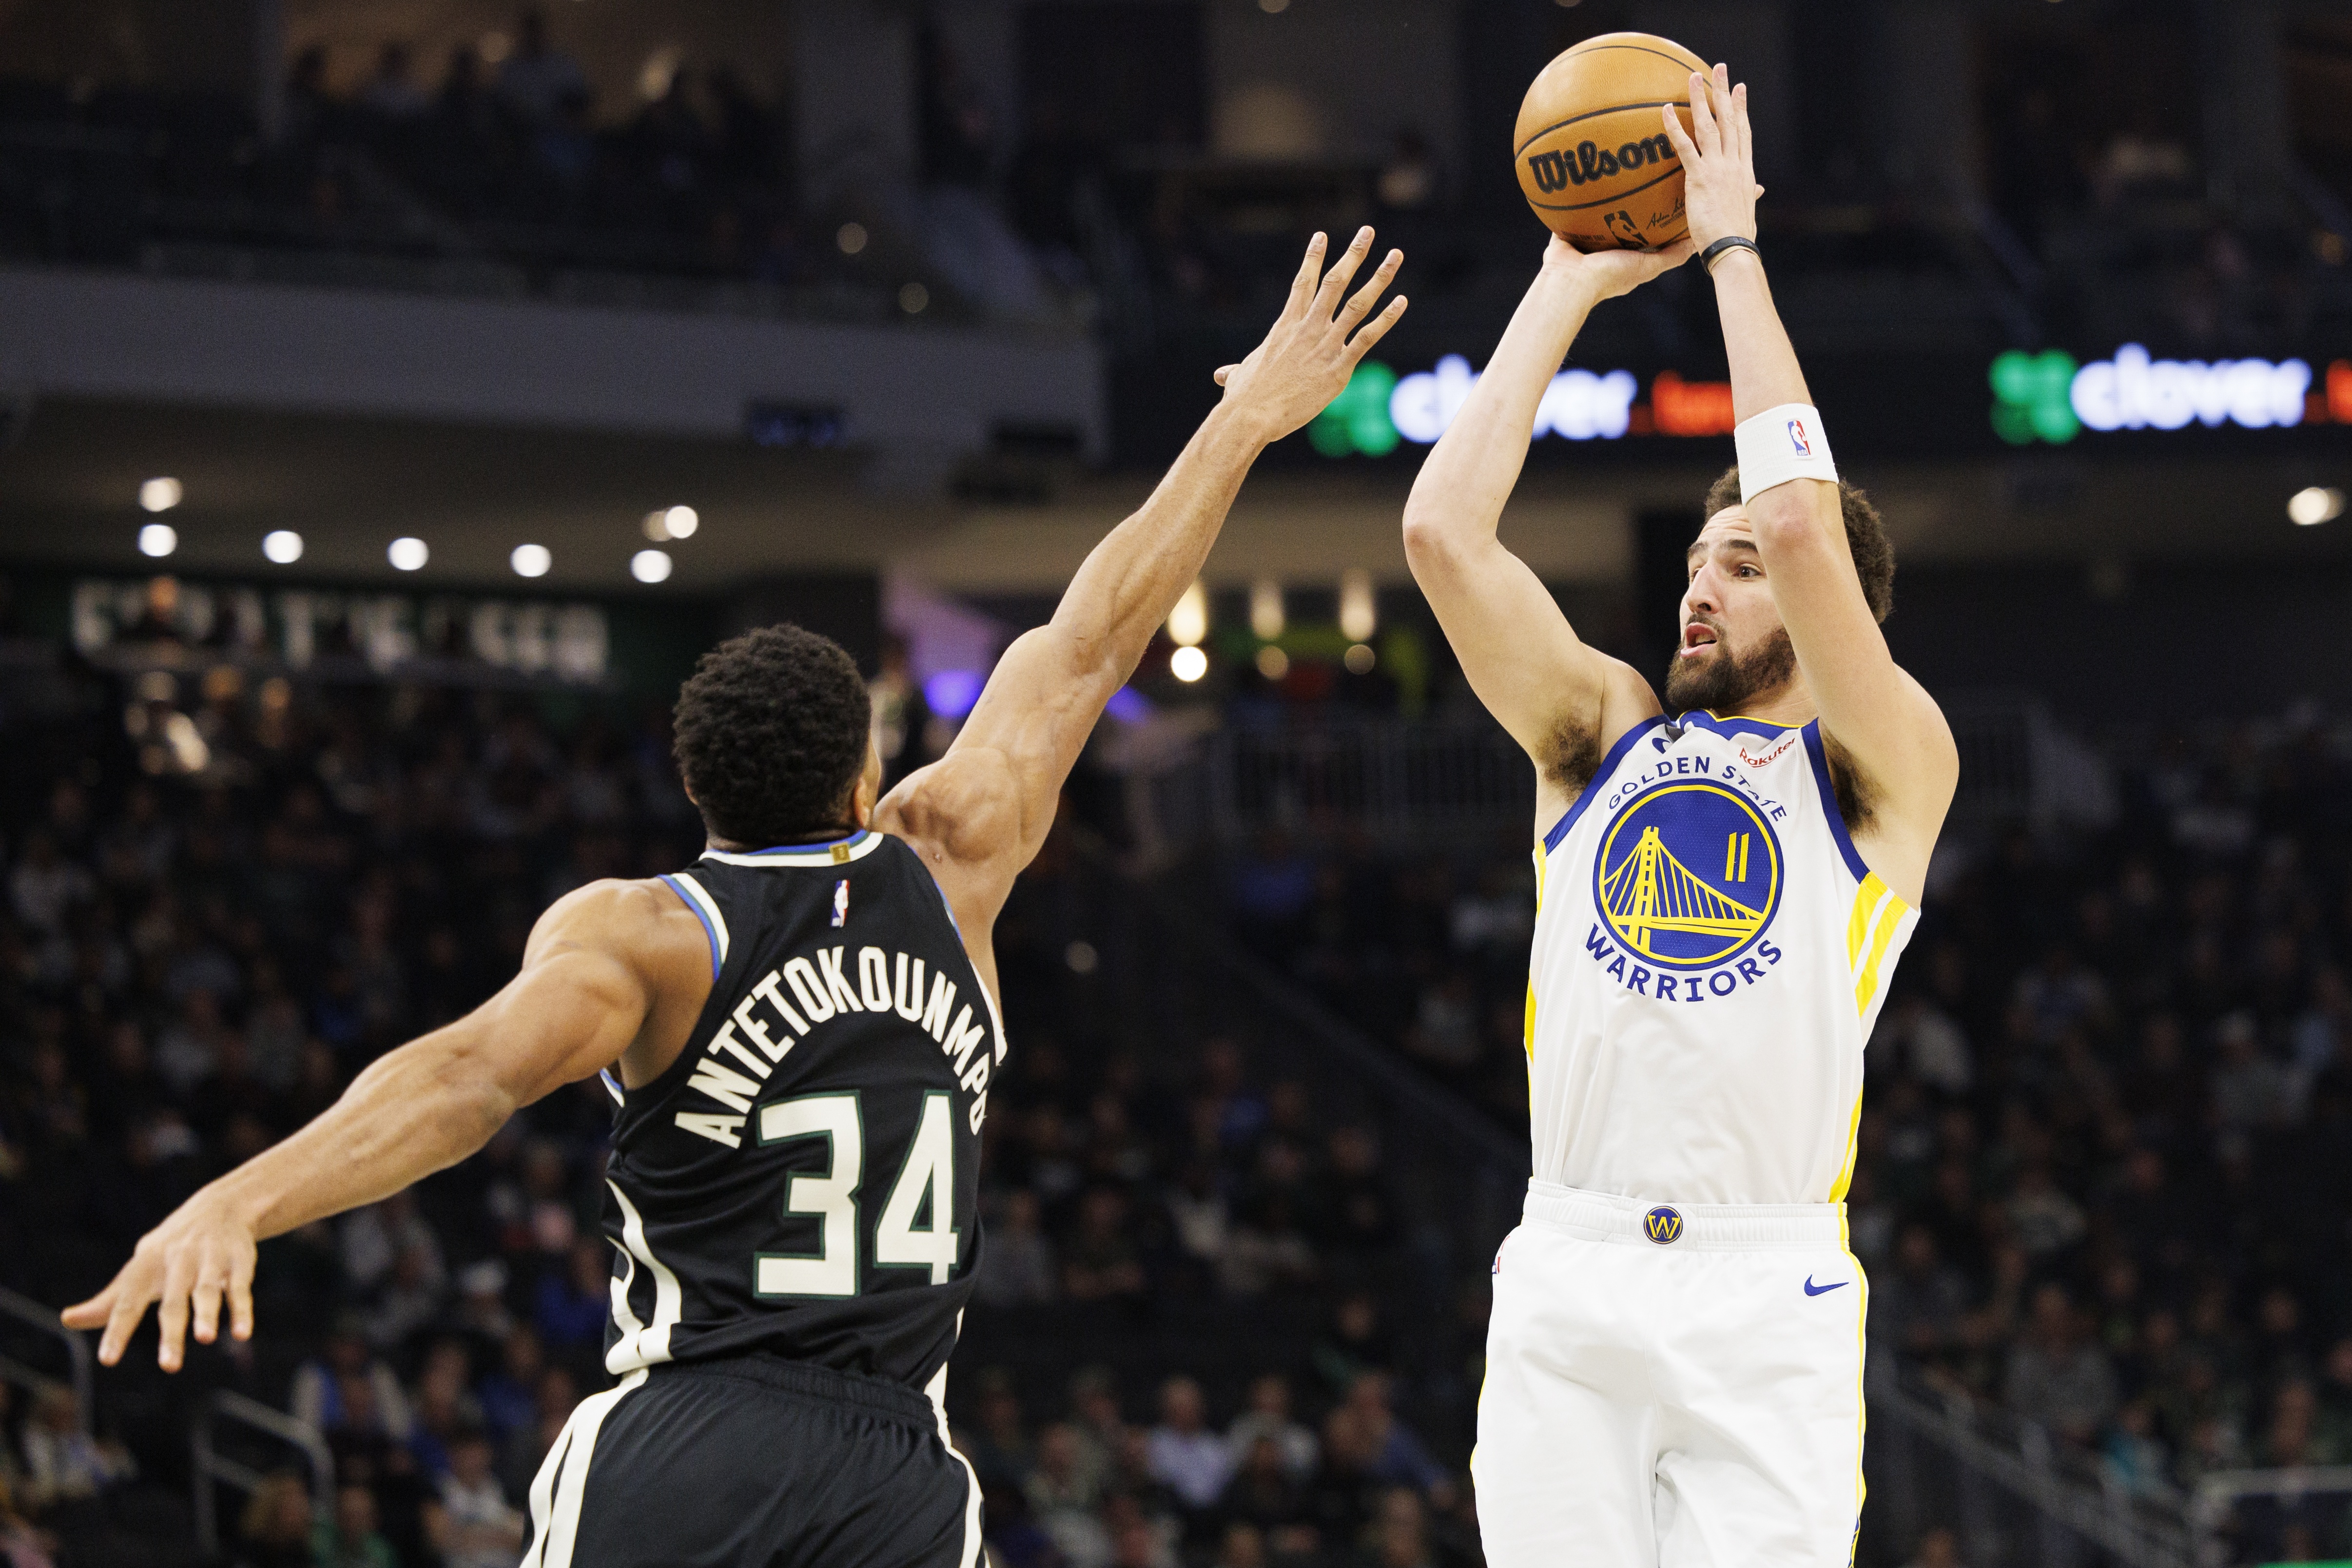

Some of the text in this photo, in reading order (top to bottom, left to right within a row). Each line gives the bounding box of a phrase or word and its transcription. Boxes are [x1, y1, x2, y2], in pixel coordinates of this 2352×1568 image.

[1528, 133, 1676, 194] Wilson
[2070, 342, 2313, 431] clover
[1609, 756, 1787, 822] GOLDEN STATE
[1725, 832, 1749, 882] 11
[1585, 922, 1782, 1002] WARRIORS
[674, 946, 990, 1149] ANTETOKOUNMPO
[753, 1088, 962, 1299] 34
[1647, 1215, 1680, 1239] W
